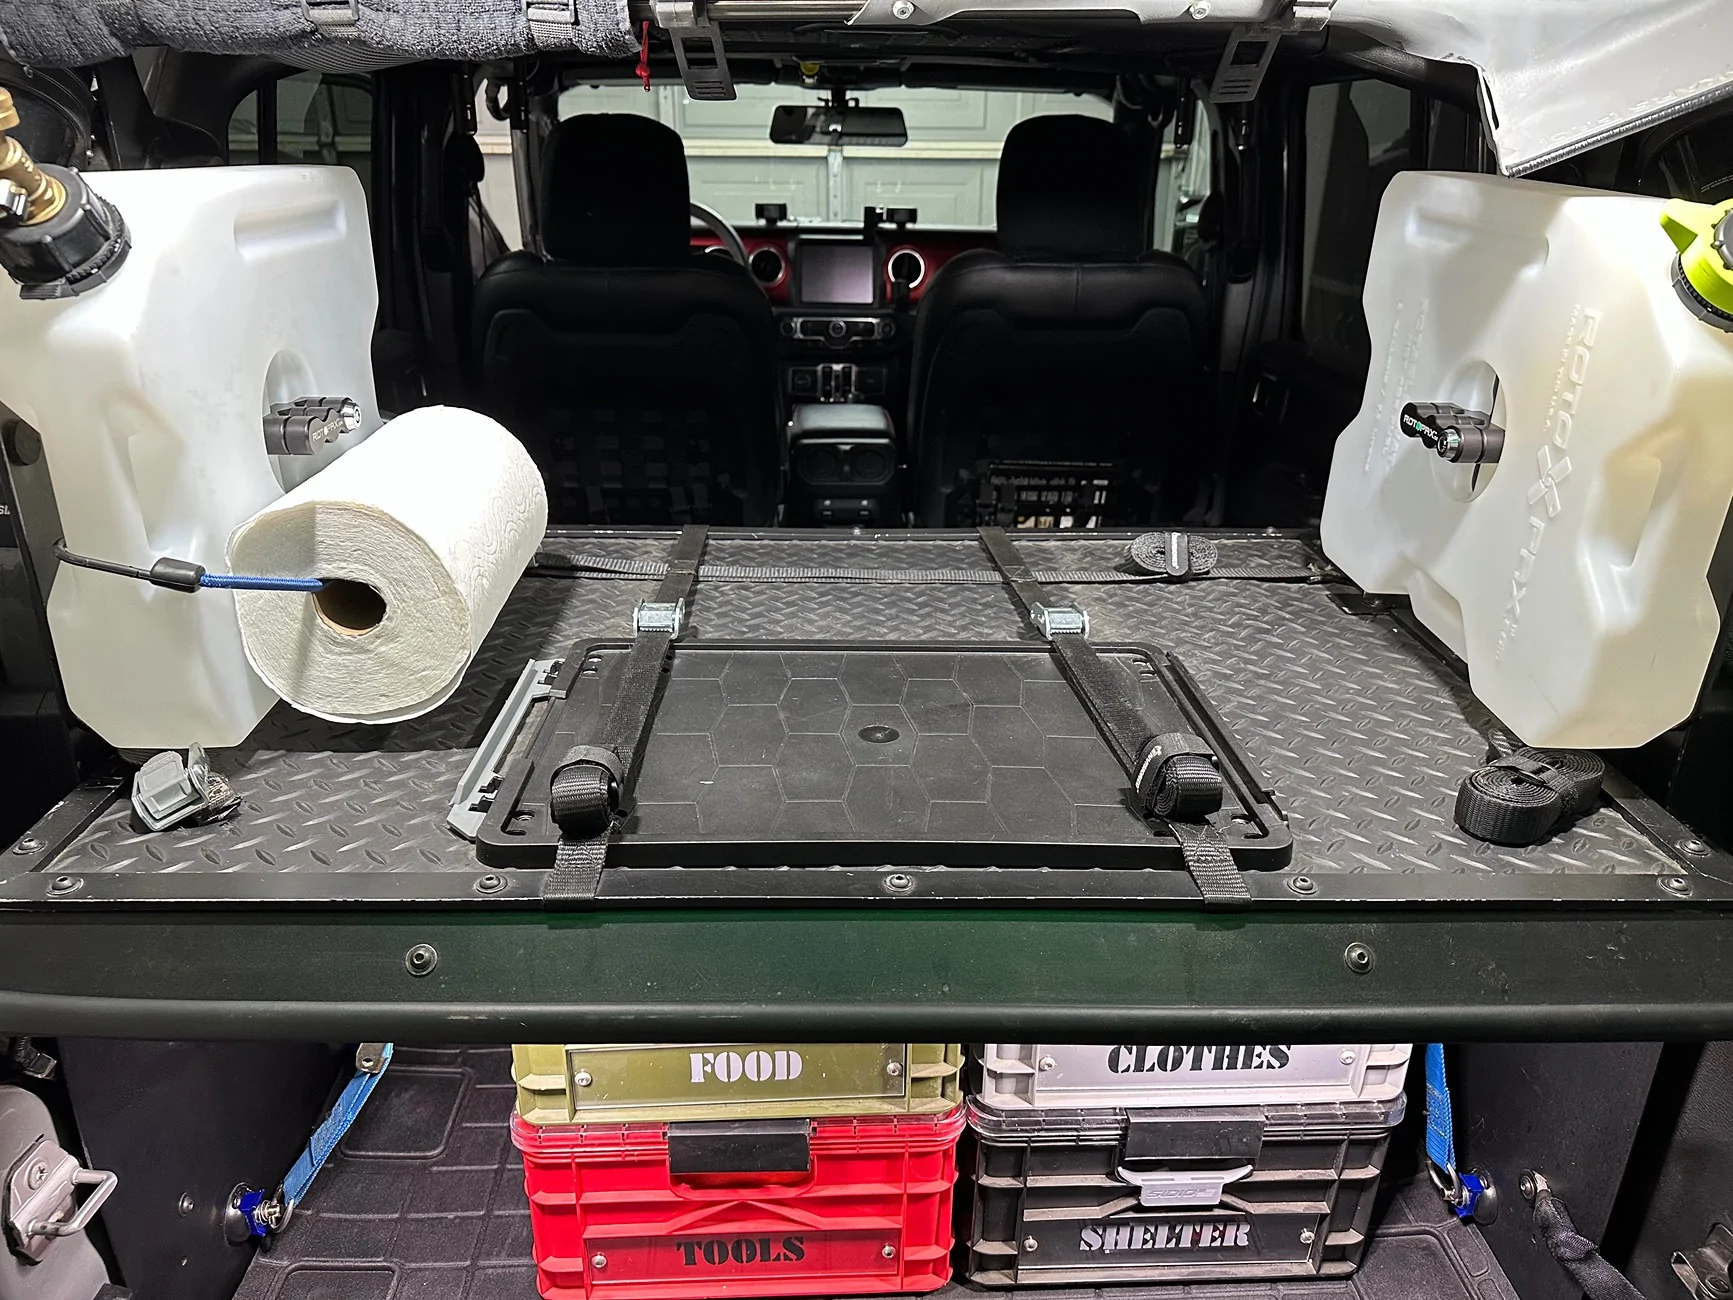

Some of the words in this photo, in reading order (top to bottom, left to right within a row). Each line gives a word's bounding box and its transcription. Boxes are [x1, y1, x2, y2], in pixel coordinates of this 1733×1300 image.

[1551, 308, 1603, 450] ROTO
[689, 1050, 803, 1083] FOOD
[1107, 1044, 1291, 1074] CLOTHES
[676, 1236, 805, 1267] TOOLS
[1079, 1221, 1251, 1252] SHELTER
